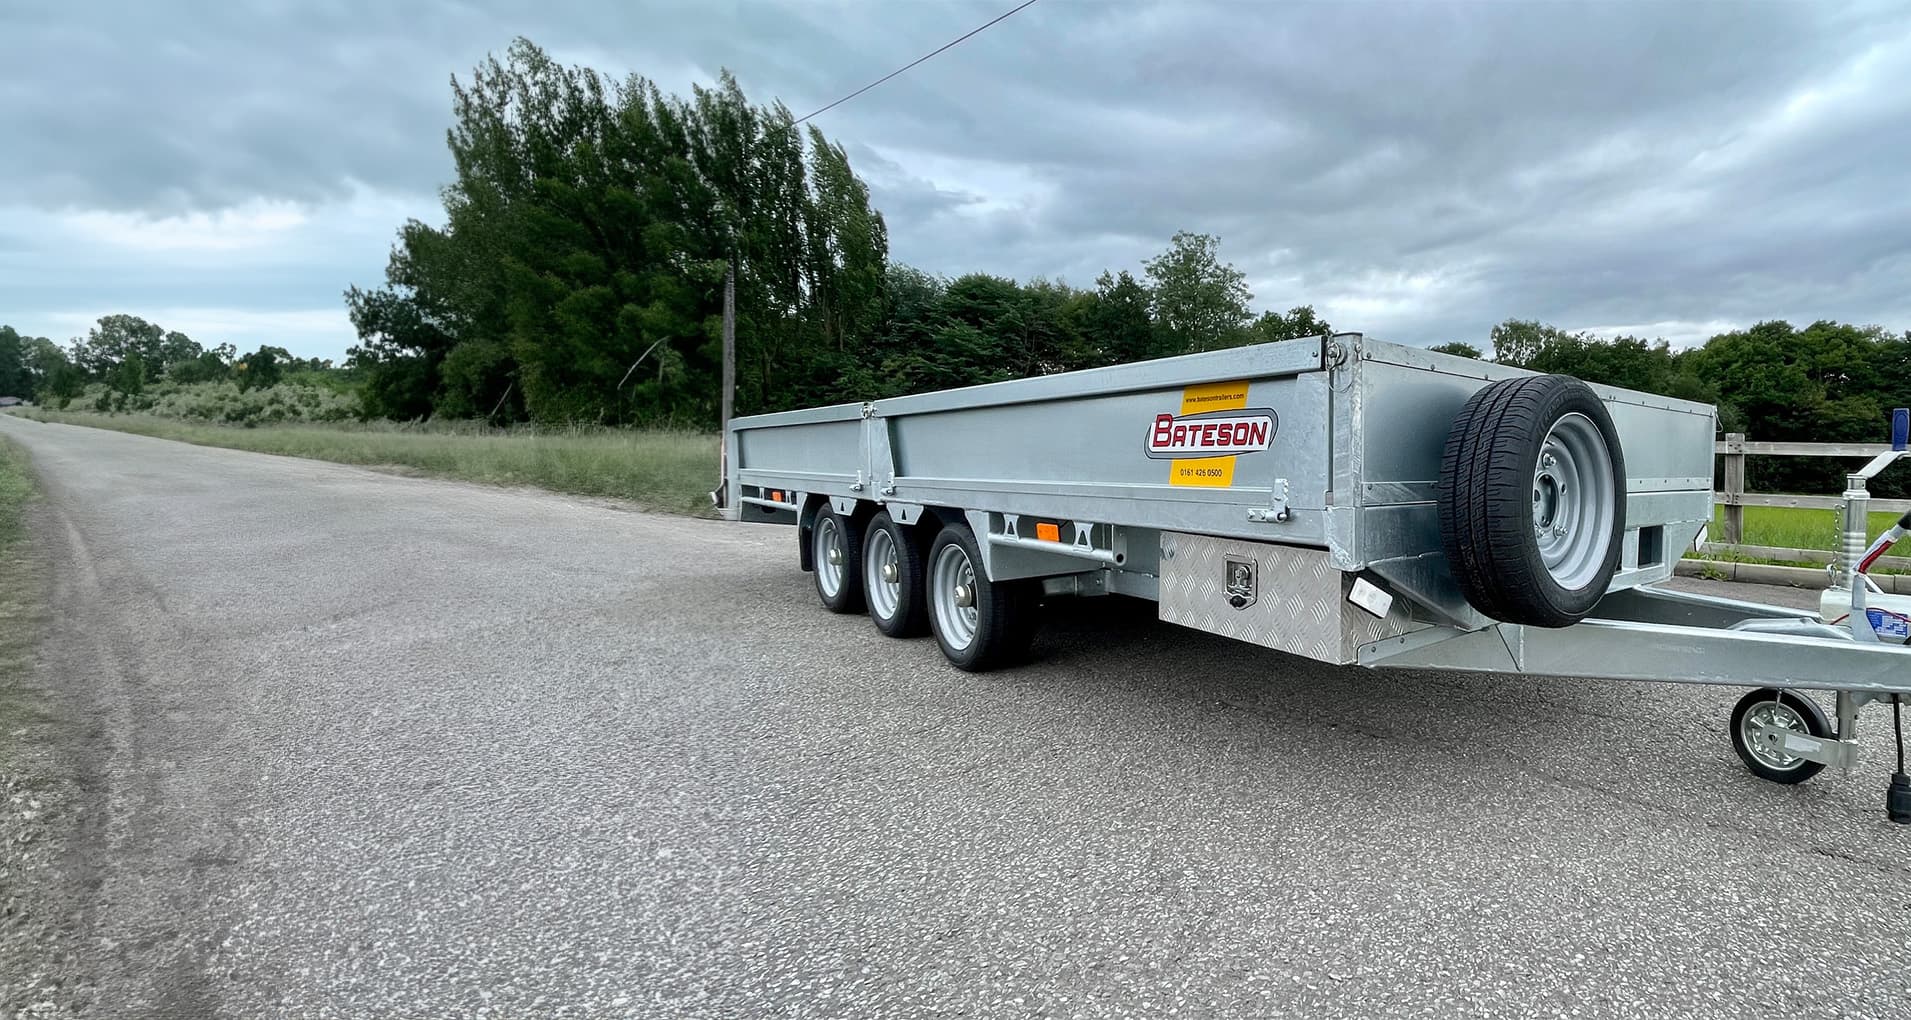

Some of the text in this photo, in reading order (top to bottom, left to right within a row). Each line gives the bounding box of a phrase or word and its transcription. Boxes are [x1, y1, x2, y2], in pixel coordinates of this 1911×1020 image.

[1152, 413, 1268, 448] BATESON
[1180, 469, 1194, 477] 0161
[1207, 469, 1223, 478] 0500
